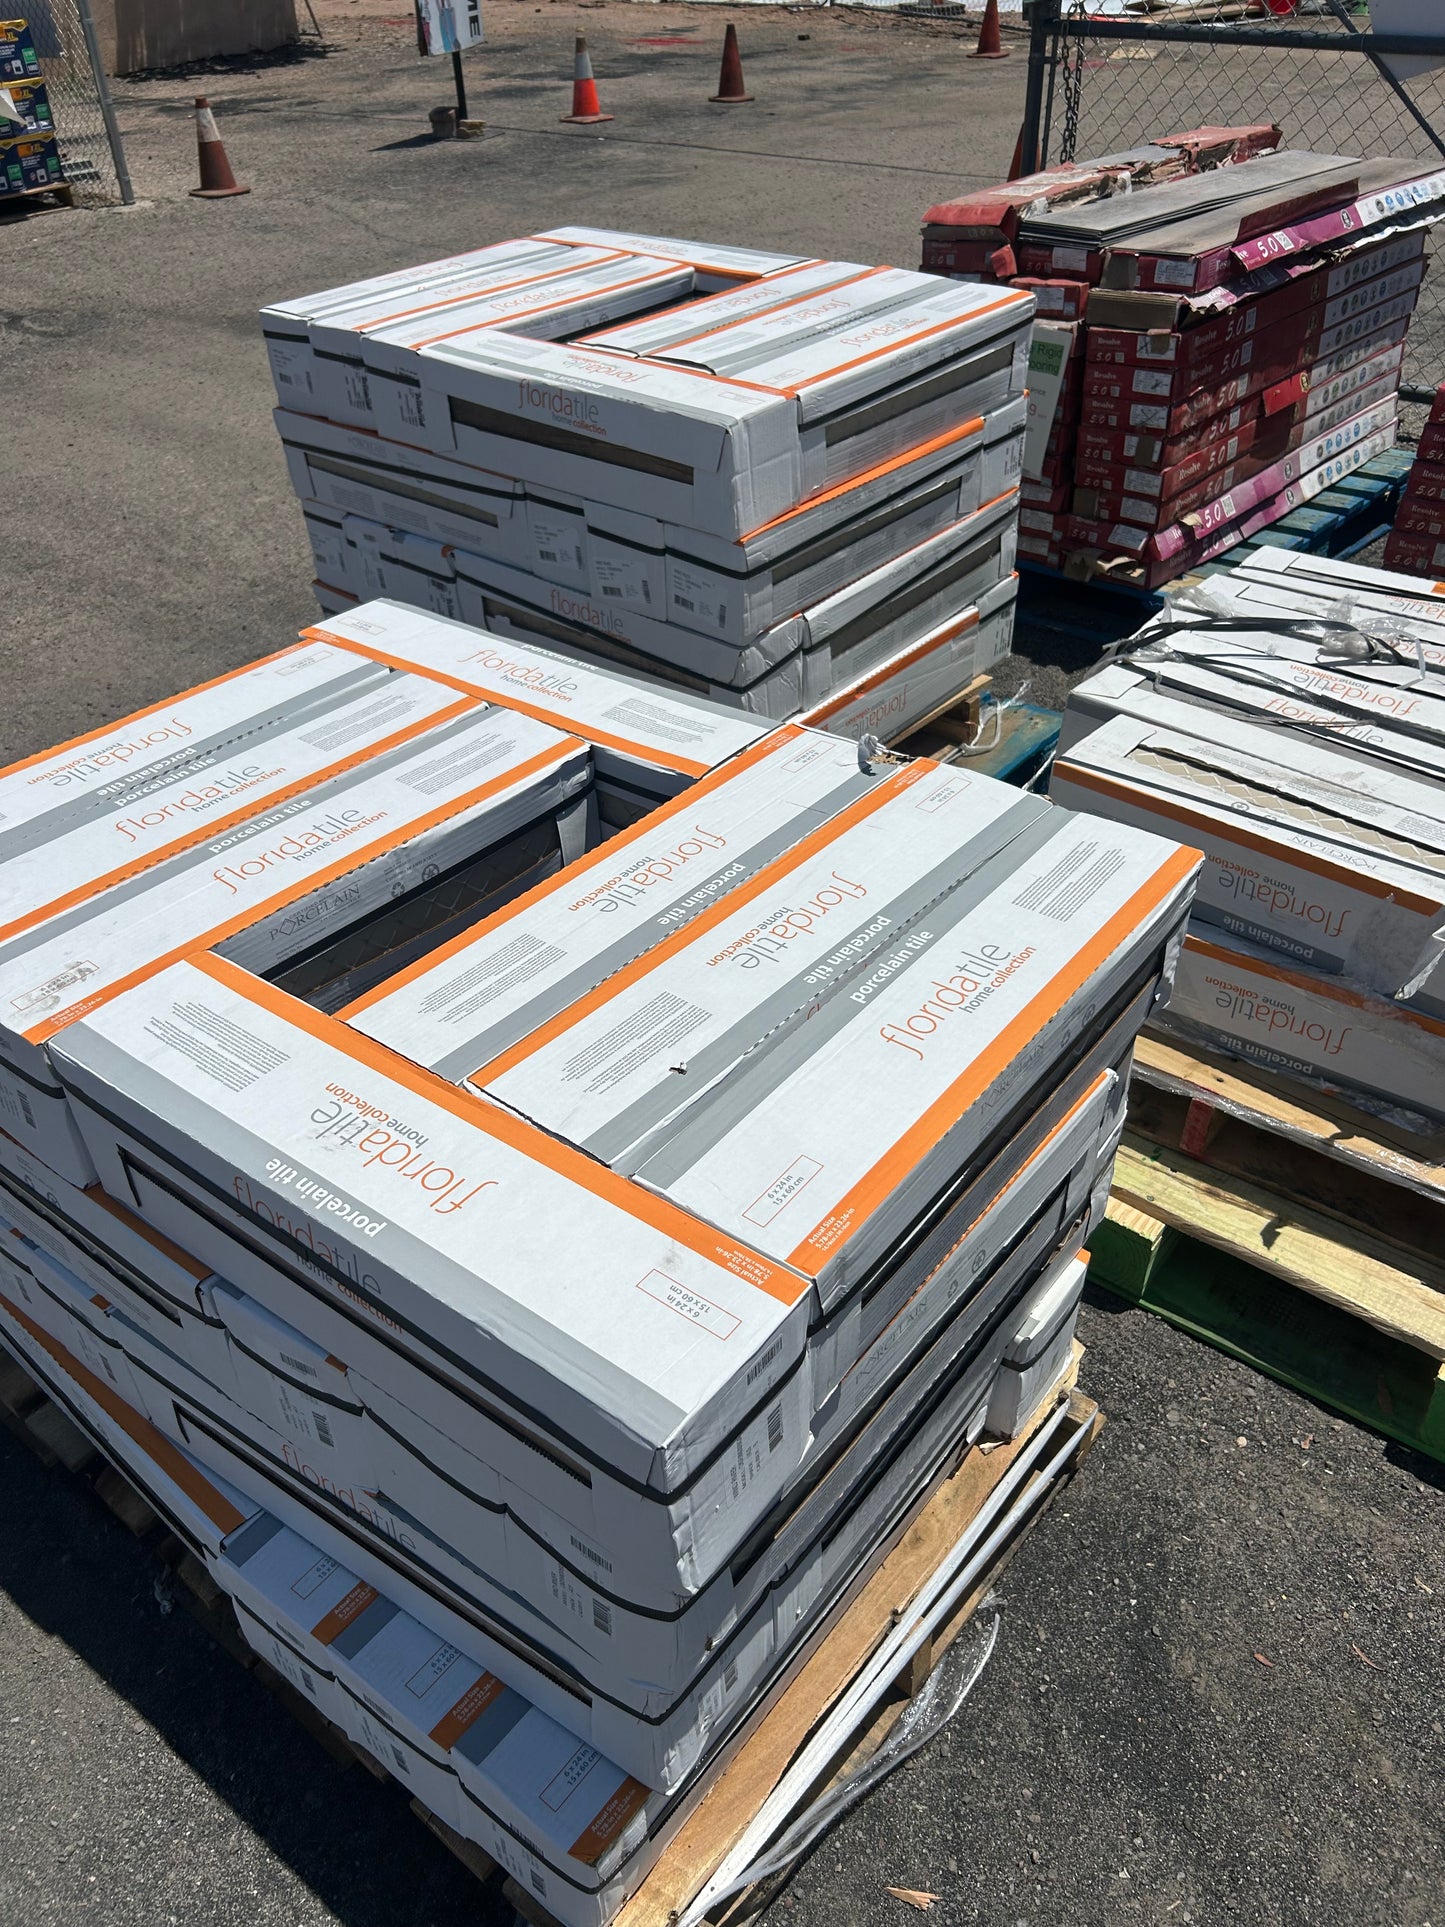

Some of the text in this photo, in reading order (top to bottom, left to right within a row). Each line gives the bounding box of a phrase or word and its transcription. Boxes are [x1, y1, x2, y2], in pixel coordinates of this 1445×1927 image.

[1257, 237, 1278, 259] 5.0
[1225, 315, 1244, 341] 5.0
[518, 378, 600, 424] floridatile
[1207, 446, 1226, 471] 5.0
[1416, 485, 1437, 497] 5.0
[1204, 503, 1222, 528] 5.0
[1405, 519, 1426, 531] 5.0
[550, 589, 624, 633] floridatile
[456, 649, 579, 695] floridatile
[500, 674, 574, 703] home collection
[1293, 672, 1422, 716] floridatile
[27, 742, 124, 786] collection home
[49, 717, 193, 788] floridatile
[96, 747, 198, 797] porcelain tile
[114, 756, 218, 807] porcelain tile
[115, 764, 266, 844] floridatile
[191, 767, 288, 813] home collection
[207, 799, 313, 855] porcelain tile
[291, 811, 389, 863] home collection
[213, 808, 369, 896] floridatile
[591, 825, 727, 913] floridatile
[1208, 854, 1296, 895] collection home
[568, 856, 656, 913] collection home
[656, 863, 747, 926] porcelain tile
[1218, 869, 1353, 938] floridatile
[706, 906, 792, 968] collection home
[731, 871, 868, 970] floridatile
[1223, 915, 1315, 960] porcelain tile
[802, 915, 893, 985] porcelain tile
[849, 929, 935, 1005] porcelain tile
[879, 943, 1011, 1061] floridatile
[958, 945, 1037, 1014] home collection
[1205, 975, 1295, 1016] collection home
[1215, 990, 1353, 1056] floridatile
[1219, 1033, 1314, 1076] porcelain tile
[325, 1082, 430, 1149] collection home
[310, 1101, 499, 1215] floridatile
[265, 1157, 388, 1238] porcelain tile
[773, 1198, 783, 1206] 15
[785, 1185, 795, 1194] 60
[793, 1176, 804, 1186] cm
[776, 1181, 786, 1190] 24
[783, 1175, 793, 1183] in
[808, 1216, 836, 1244] Actual Size
[727, 1261, 742, 1272] Size
[742, 1270, 764, 1285] Actual
[667, 1294, 676, 1304] in
[670, 1285, 682, 1295] cm
[675, 1300, 687, 1311] 24
[681, 1294, 694, 1303] 60
[699, 1304, 711, 1313] 15
[567, 1776, 577, 1785] 15
[580, 1761, 588, 1772] 60
[588, 1751, 599, 1762] cm
